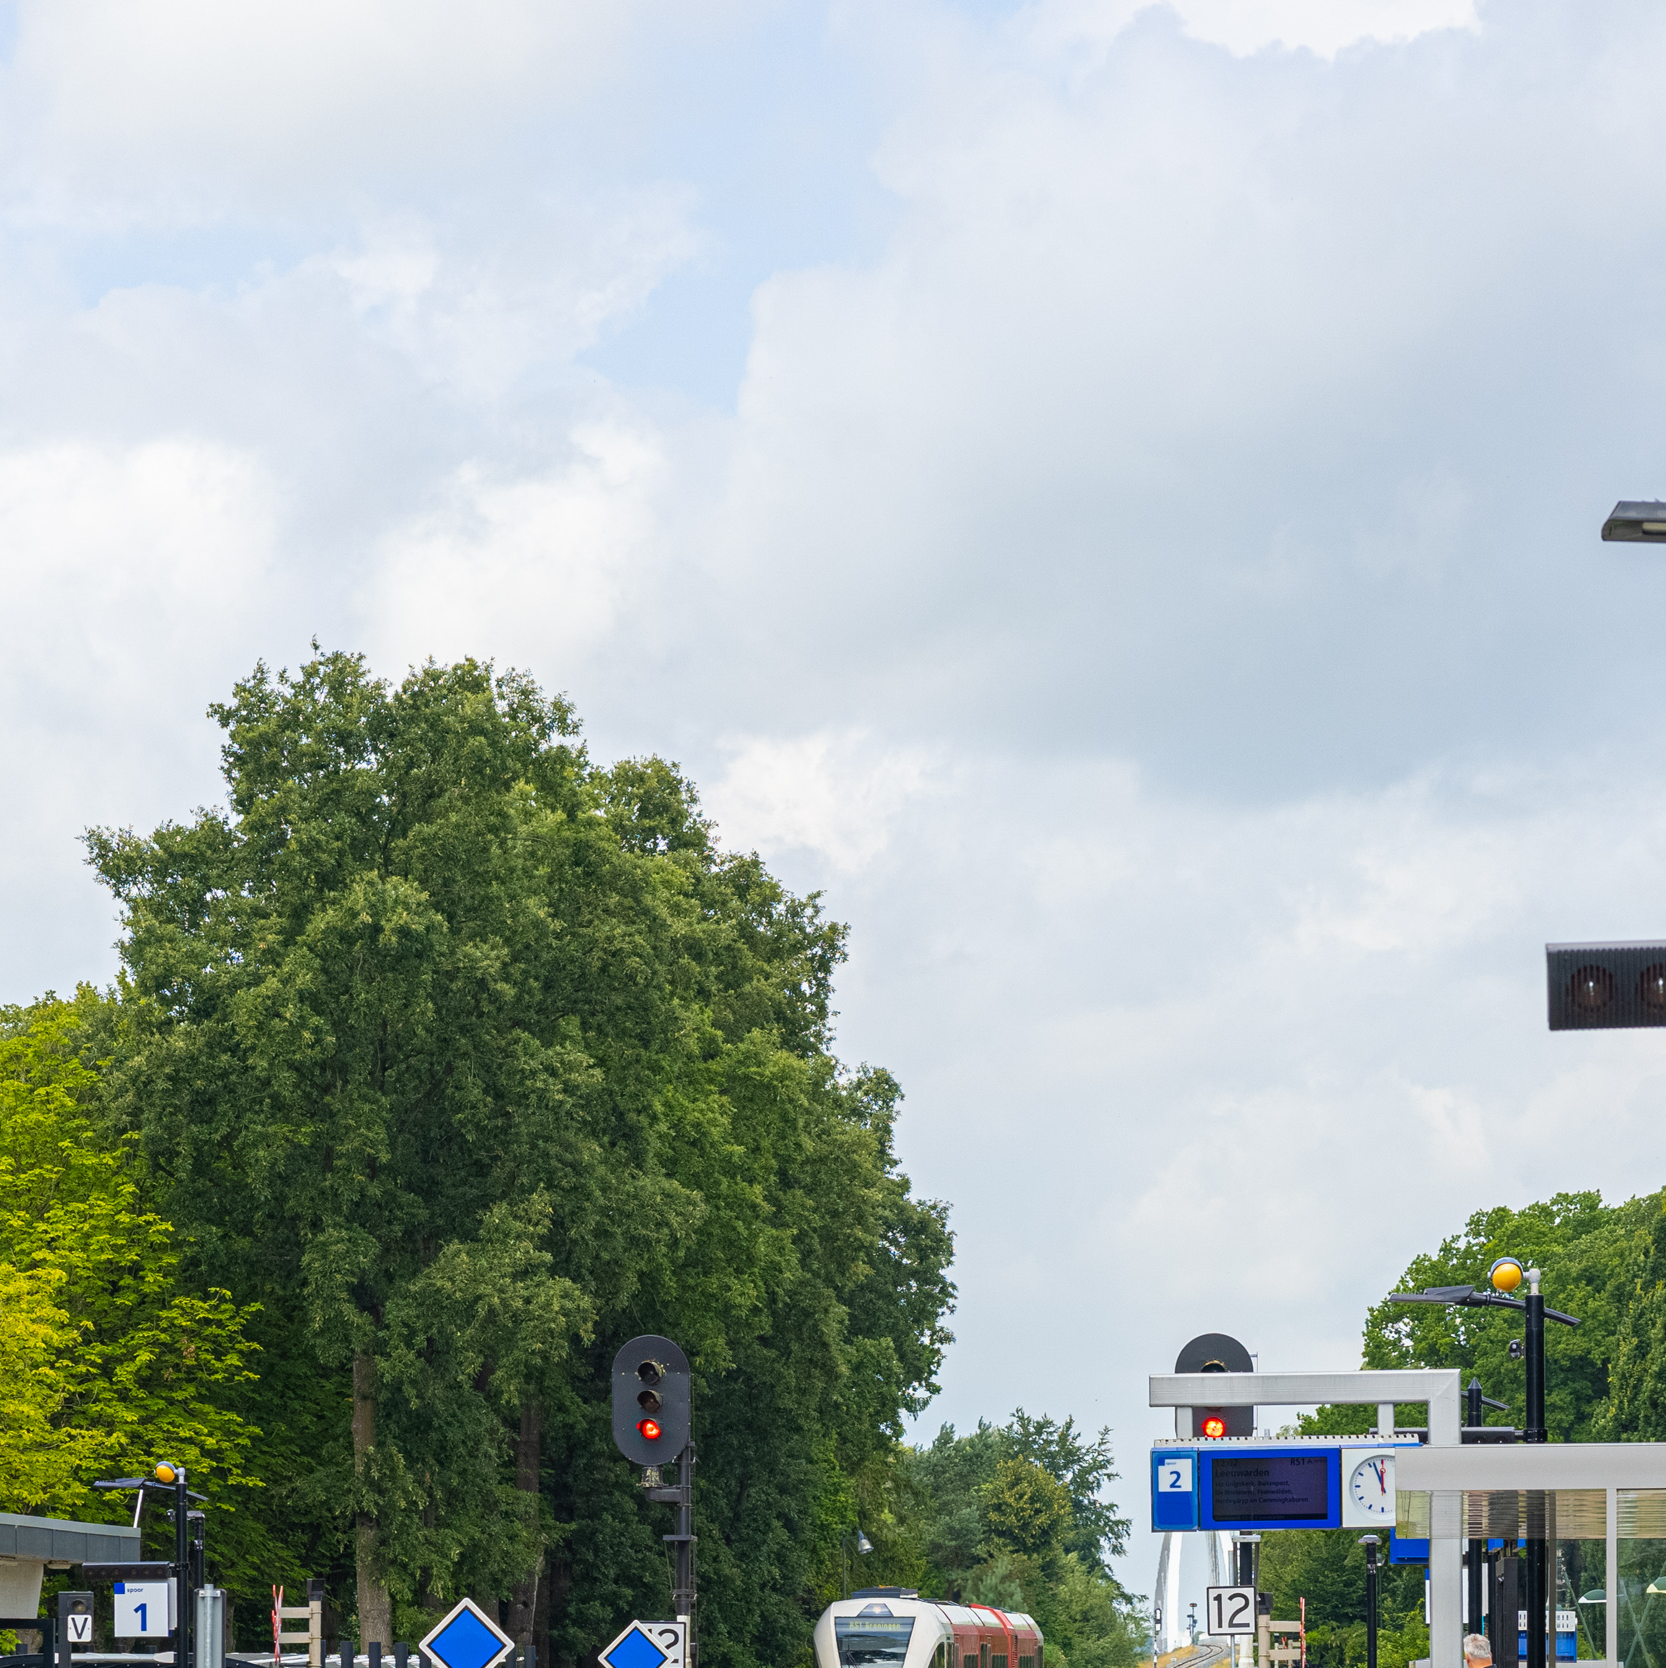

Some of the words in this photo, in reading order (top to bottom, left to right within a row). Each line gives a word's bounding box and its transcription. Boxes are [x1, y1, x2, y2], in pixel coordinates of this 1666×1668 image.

[1215, 1468, 1270, 1477] Leeuwarden
[1290, 1458, 1305, 1466] RS1
[1169, 1470, 1181, 1488] 2
[133, 1603, 147, 1632] 1
[1213, 1593, 1250, 1628] 12
[71, 1617, 89, 1639] V
[648, 1628, 679, 1664] 2
